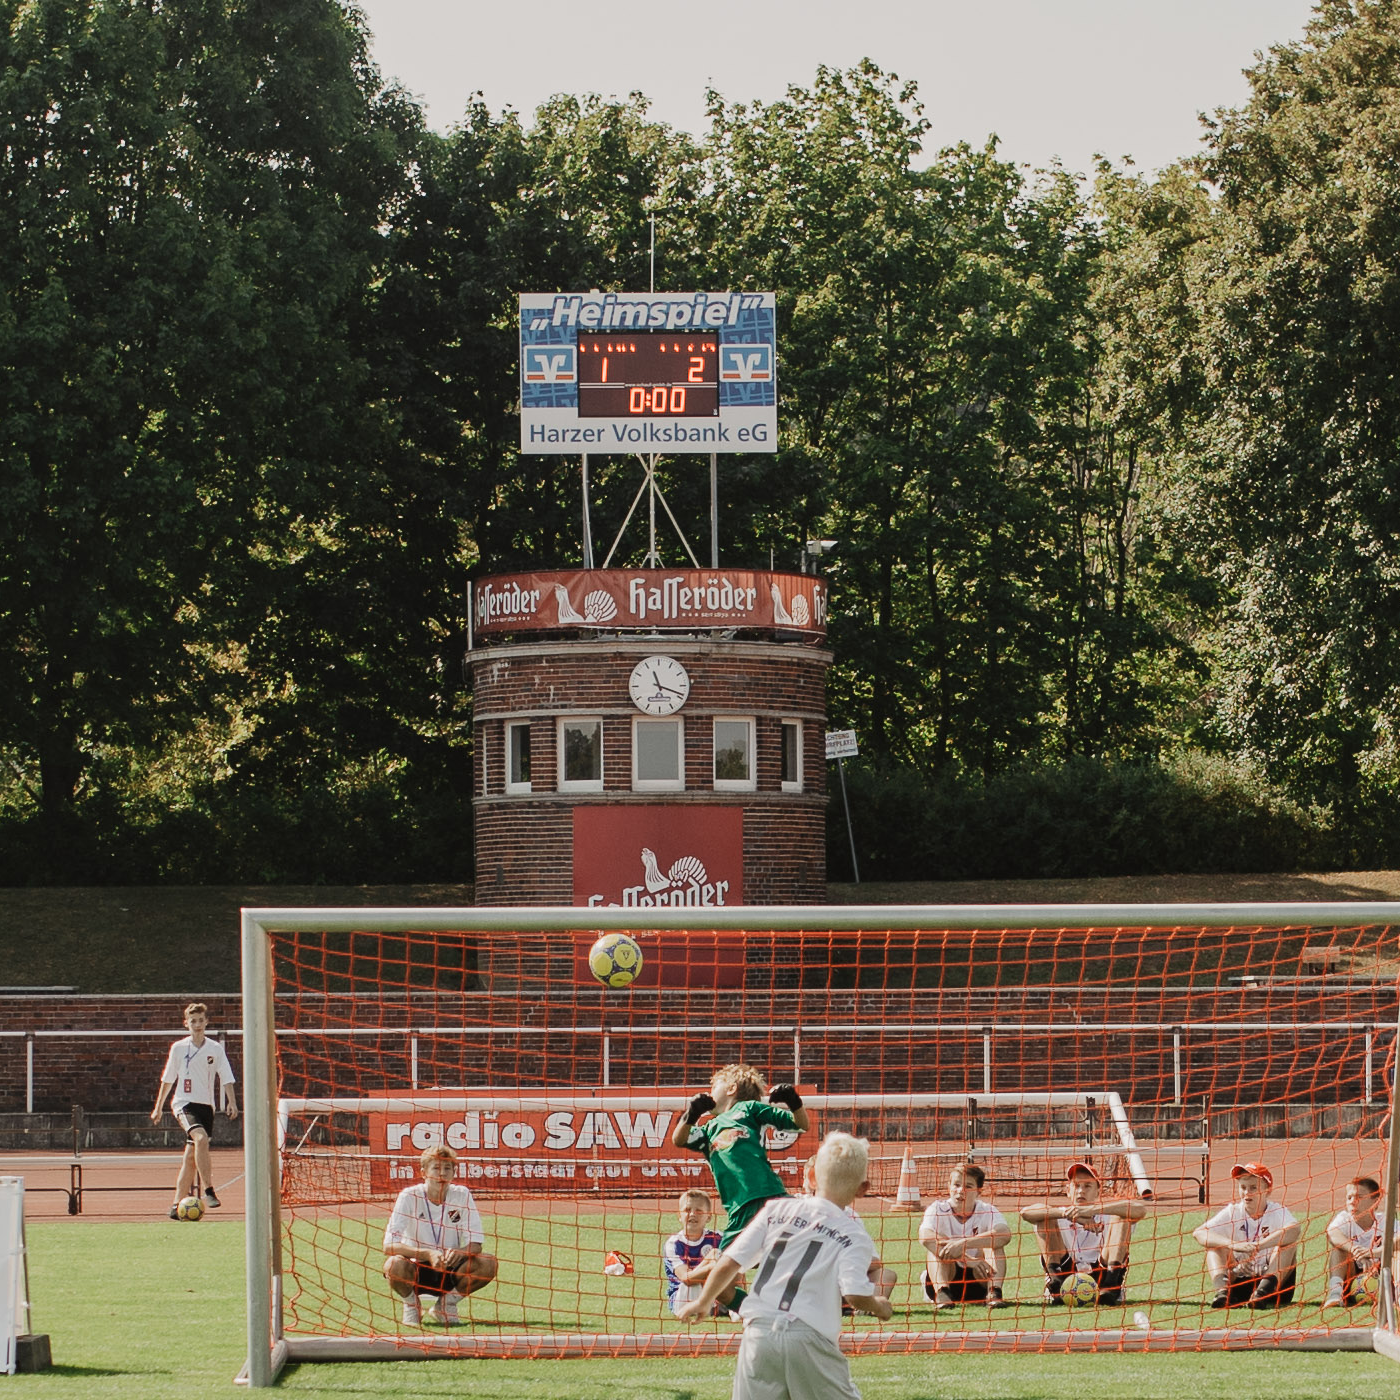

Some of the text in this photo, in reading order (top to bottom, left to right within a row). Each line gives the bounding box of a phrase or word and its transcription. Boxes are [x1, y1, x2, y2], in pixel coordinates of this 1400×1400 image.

[601, 356, 705, 383] 1 2
[629, 386, 686, 413] 0:00
[529, 422, 768, 443] Harzer Volksbank eG
[386, 1111, 673, 1150] radio SAW
[753, 1231, 824, 1312] 11
